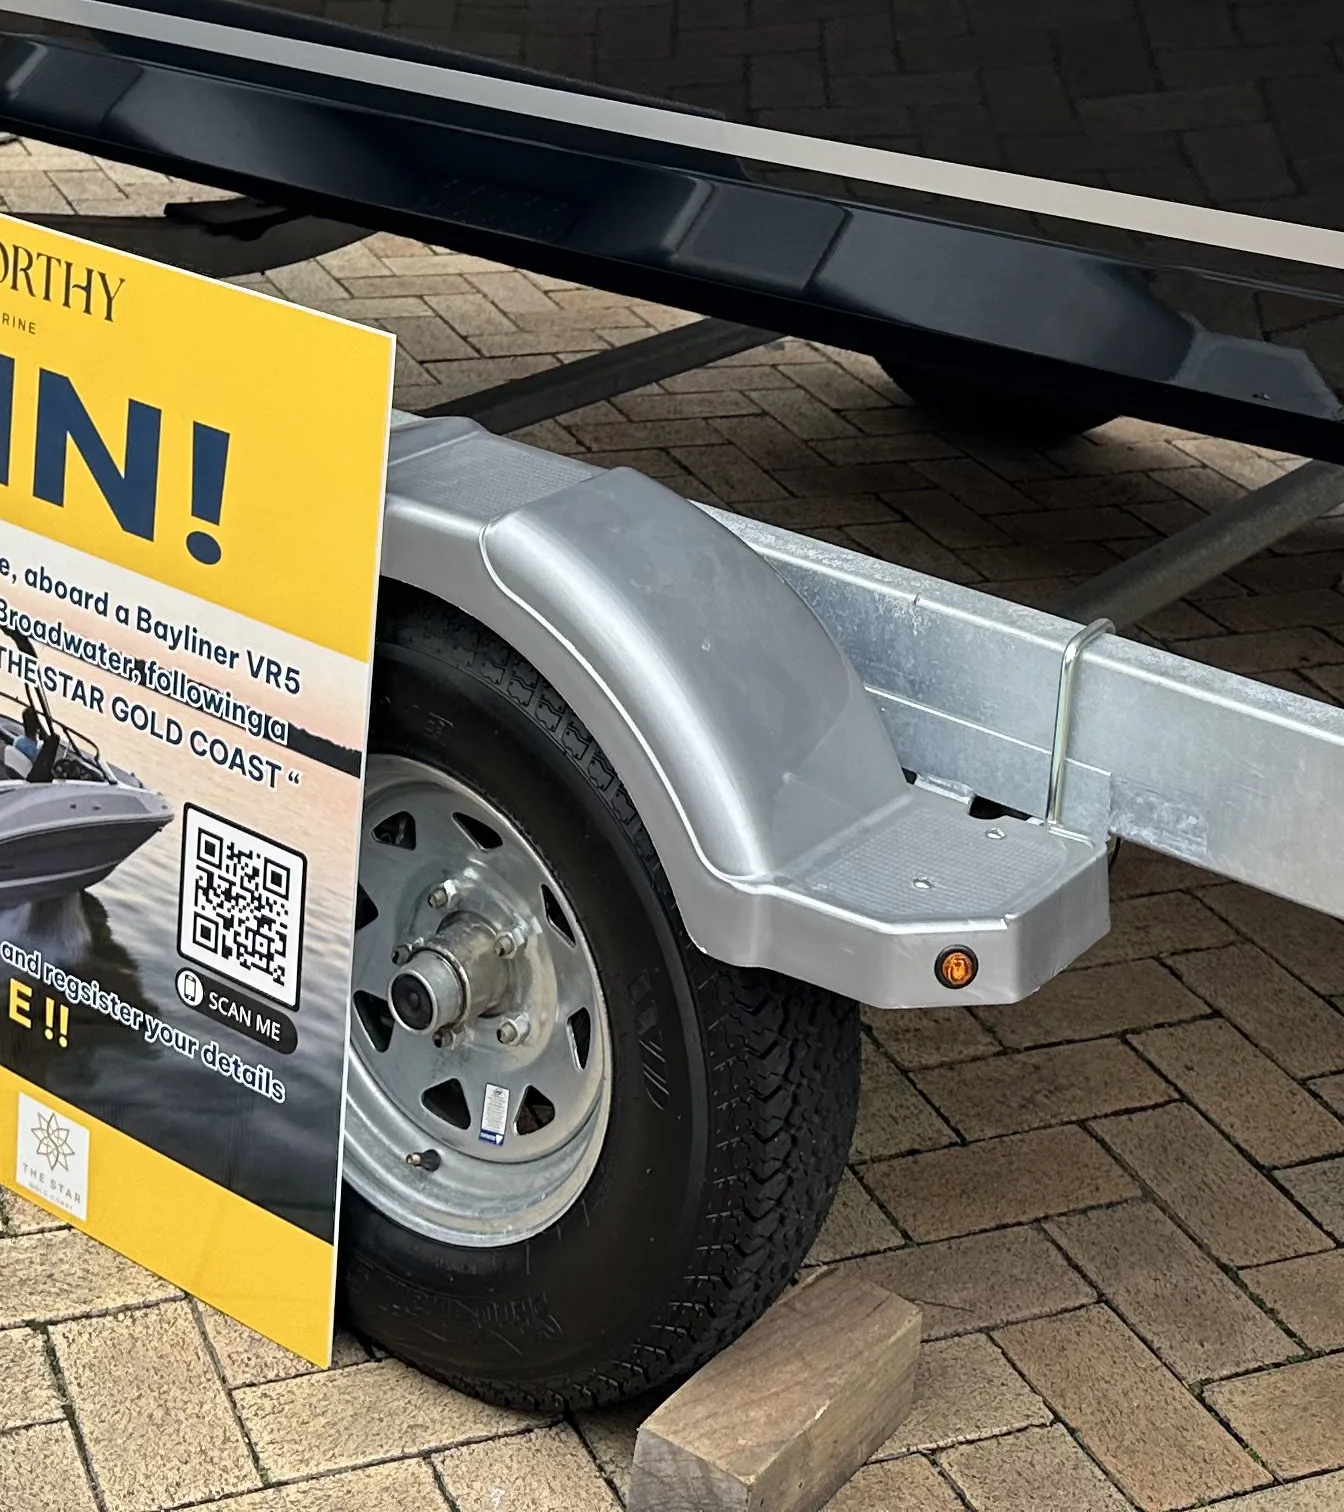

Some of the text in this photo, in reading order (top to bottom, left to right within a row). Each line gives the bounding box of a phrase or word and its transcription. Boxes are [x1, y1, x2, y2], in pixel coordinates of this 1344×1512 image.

[25, 567, 109, 617] aboard
[116, 604, 129, 626] a
[137, 606, 239, 669] Bayliner
[246, 650, 301, 694] VR5
[43, 666, 104, 713] STAR
[112, 696, 183, 745] GOLD
[190, 730, 281, 788] COAST
[147, 660, 265, 737] following
[269, 717, 288, 743] a
[0, 941, 41, 980] and
[43, 962, 143, 1030] regsister
[145, 1015, 199, 1059] your
[201, 1042, 286, 1103] details
[208, 991, 281, 1042] SCAN ME
[22, 1163, 81, 1204] THE STAR
